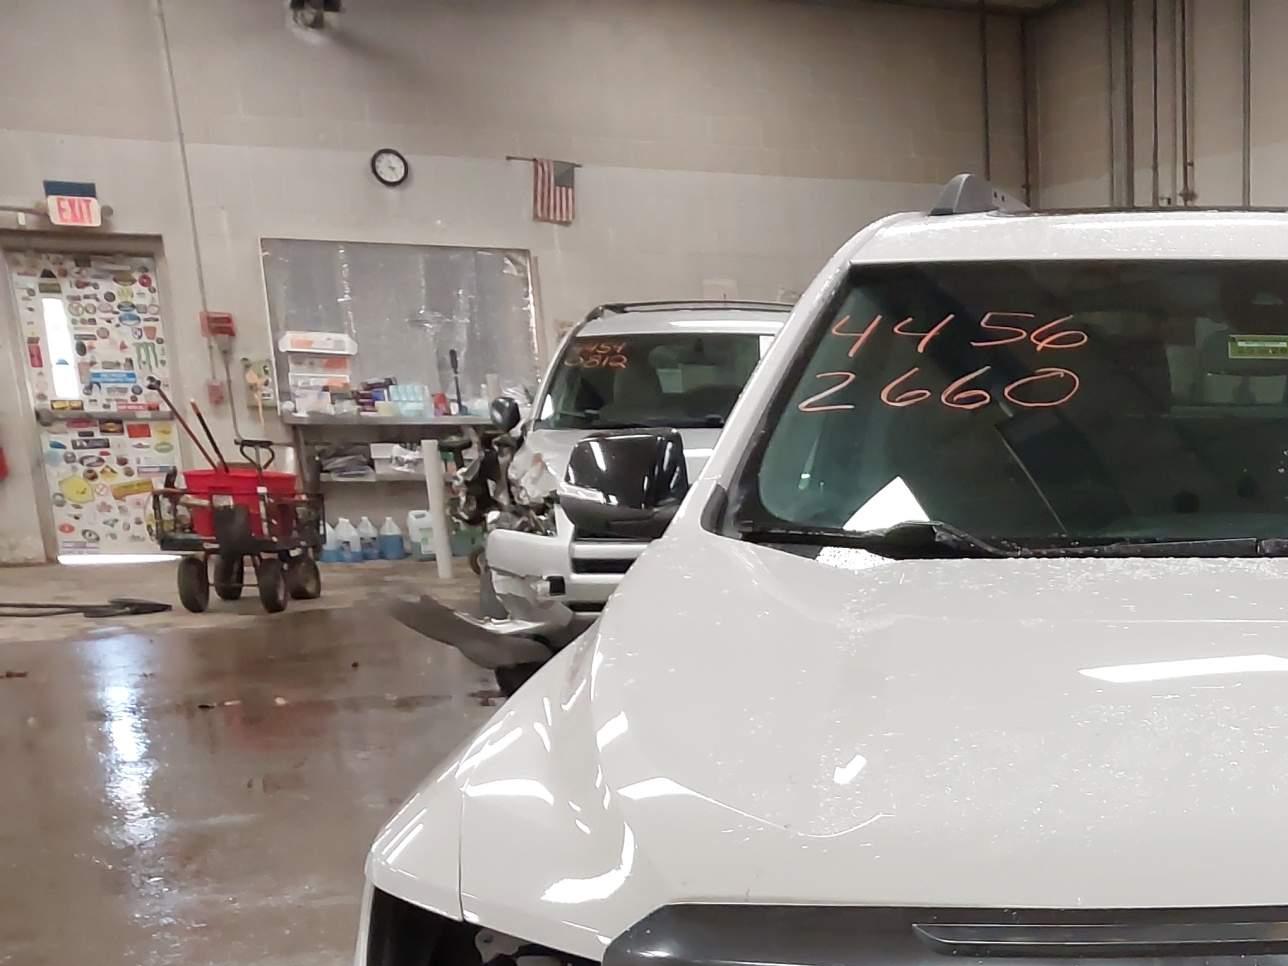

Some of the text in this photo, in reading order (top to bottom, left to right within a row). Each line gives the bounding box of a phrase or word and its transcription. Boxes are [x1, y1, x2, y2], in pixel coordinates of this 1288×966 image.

[56, 197, 93, 224] EXIT
[830, 311, 1089, 359] 4456
[797, 365, 1081, 413] 2660
